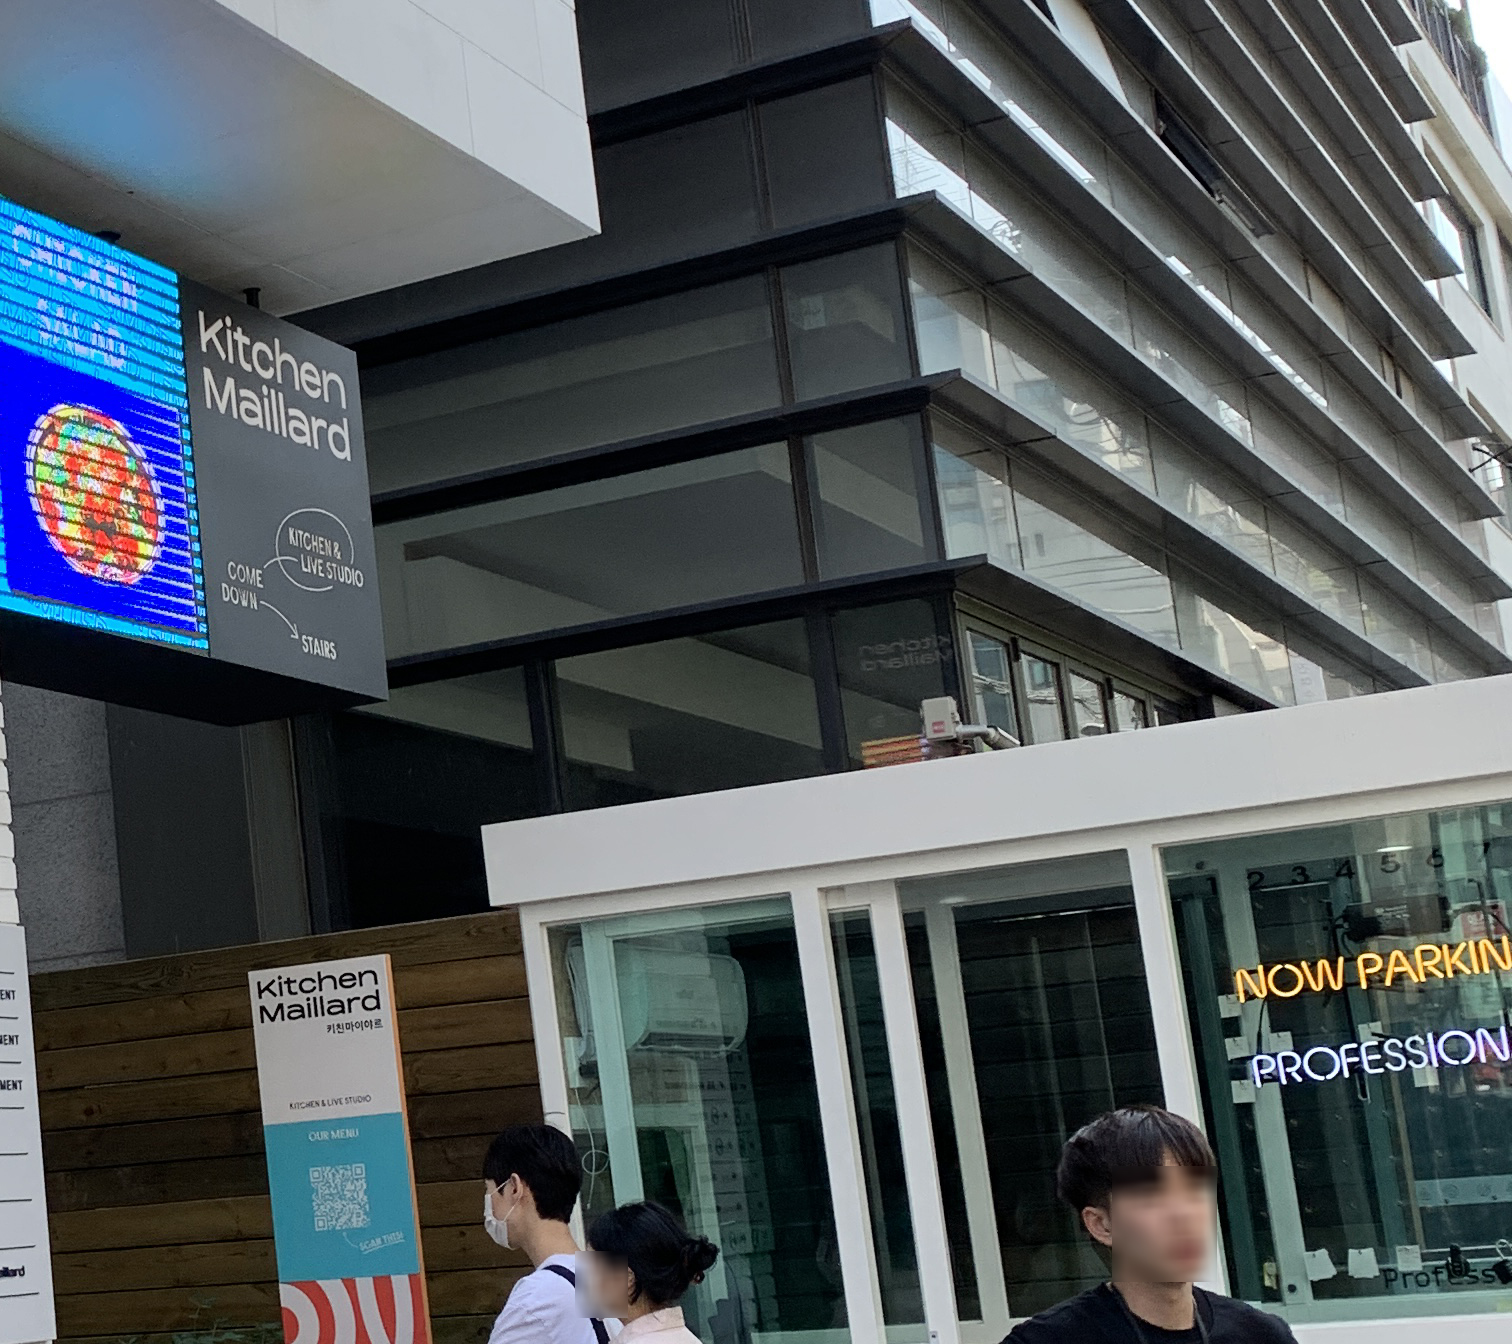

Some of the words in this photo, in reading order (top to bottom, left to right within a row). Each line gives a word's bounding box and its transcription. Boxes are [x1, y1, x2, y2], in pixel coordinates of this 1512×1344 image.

[197, 310, 347, 409] Kitchen
[202, 367, 352, 462] Maillard
[289, 527, 331, 556] KITCHEN
[333, 541, 342, 560] &
[228, 561, 264, 588] COME
[301, 554, 325, 578] LIVE
[326, 561, 364, 587] STUDIO
[221, 583, 258, 611] DOWN
[301, 635, 337, 660] STAIRS
[1247, 871, 1267, 890] 2
[1292, 865, 1310, 884] 3
[1335, 859, 1356, 880] 4
[1380, 854, 1400, 873] 5
[257, 969, 378, 1000] Kitchen
[1235, 956, 1345, 1004] NOW
[1356, 935, 1512, 990] PARKIN
[259, 989, 381, 1024] Maillard
[326, 1018, 384, 1034] 키친마이야르
[1251, 1026, 1511, 1088] PROFESSION
[289, 1099, 320, 1110] KITCHEN
[327, 1097, 343, 1107] LIVE
[344, 1094, 372, 1105] STUDIO
[308, 1130, 329, 1142] OUR
[330, 1128, 359, 1140] MENU
